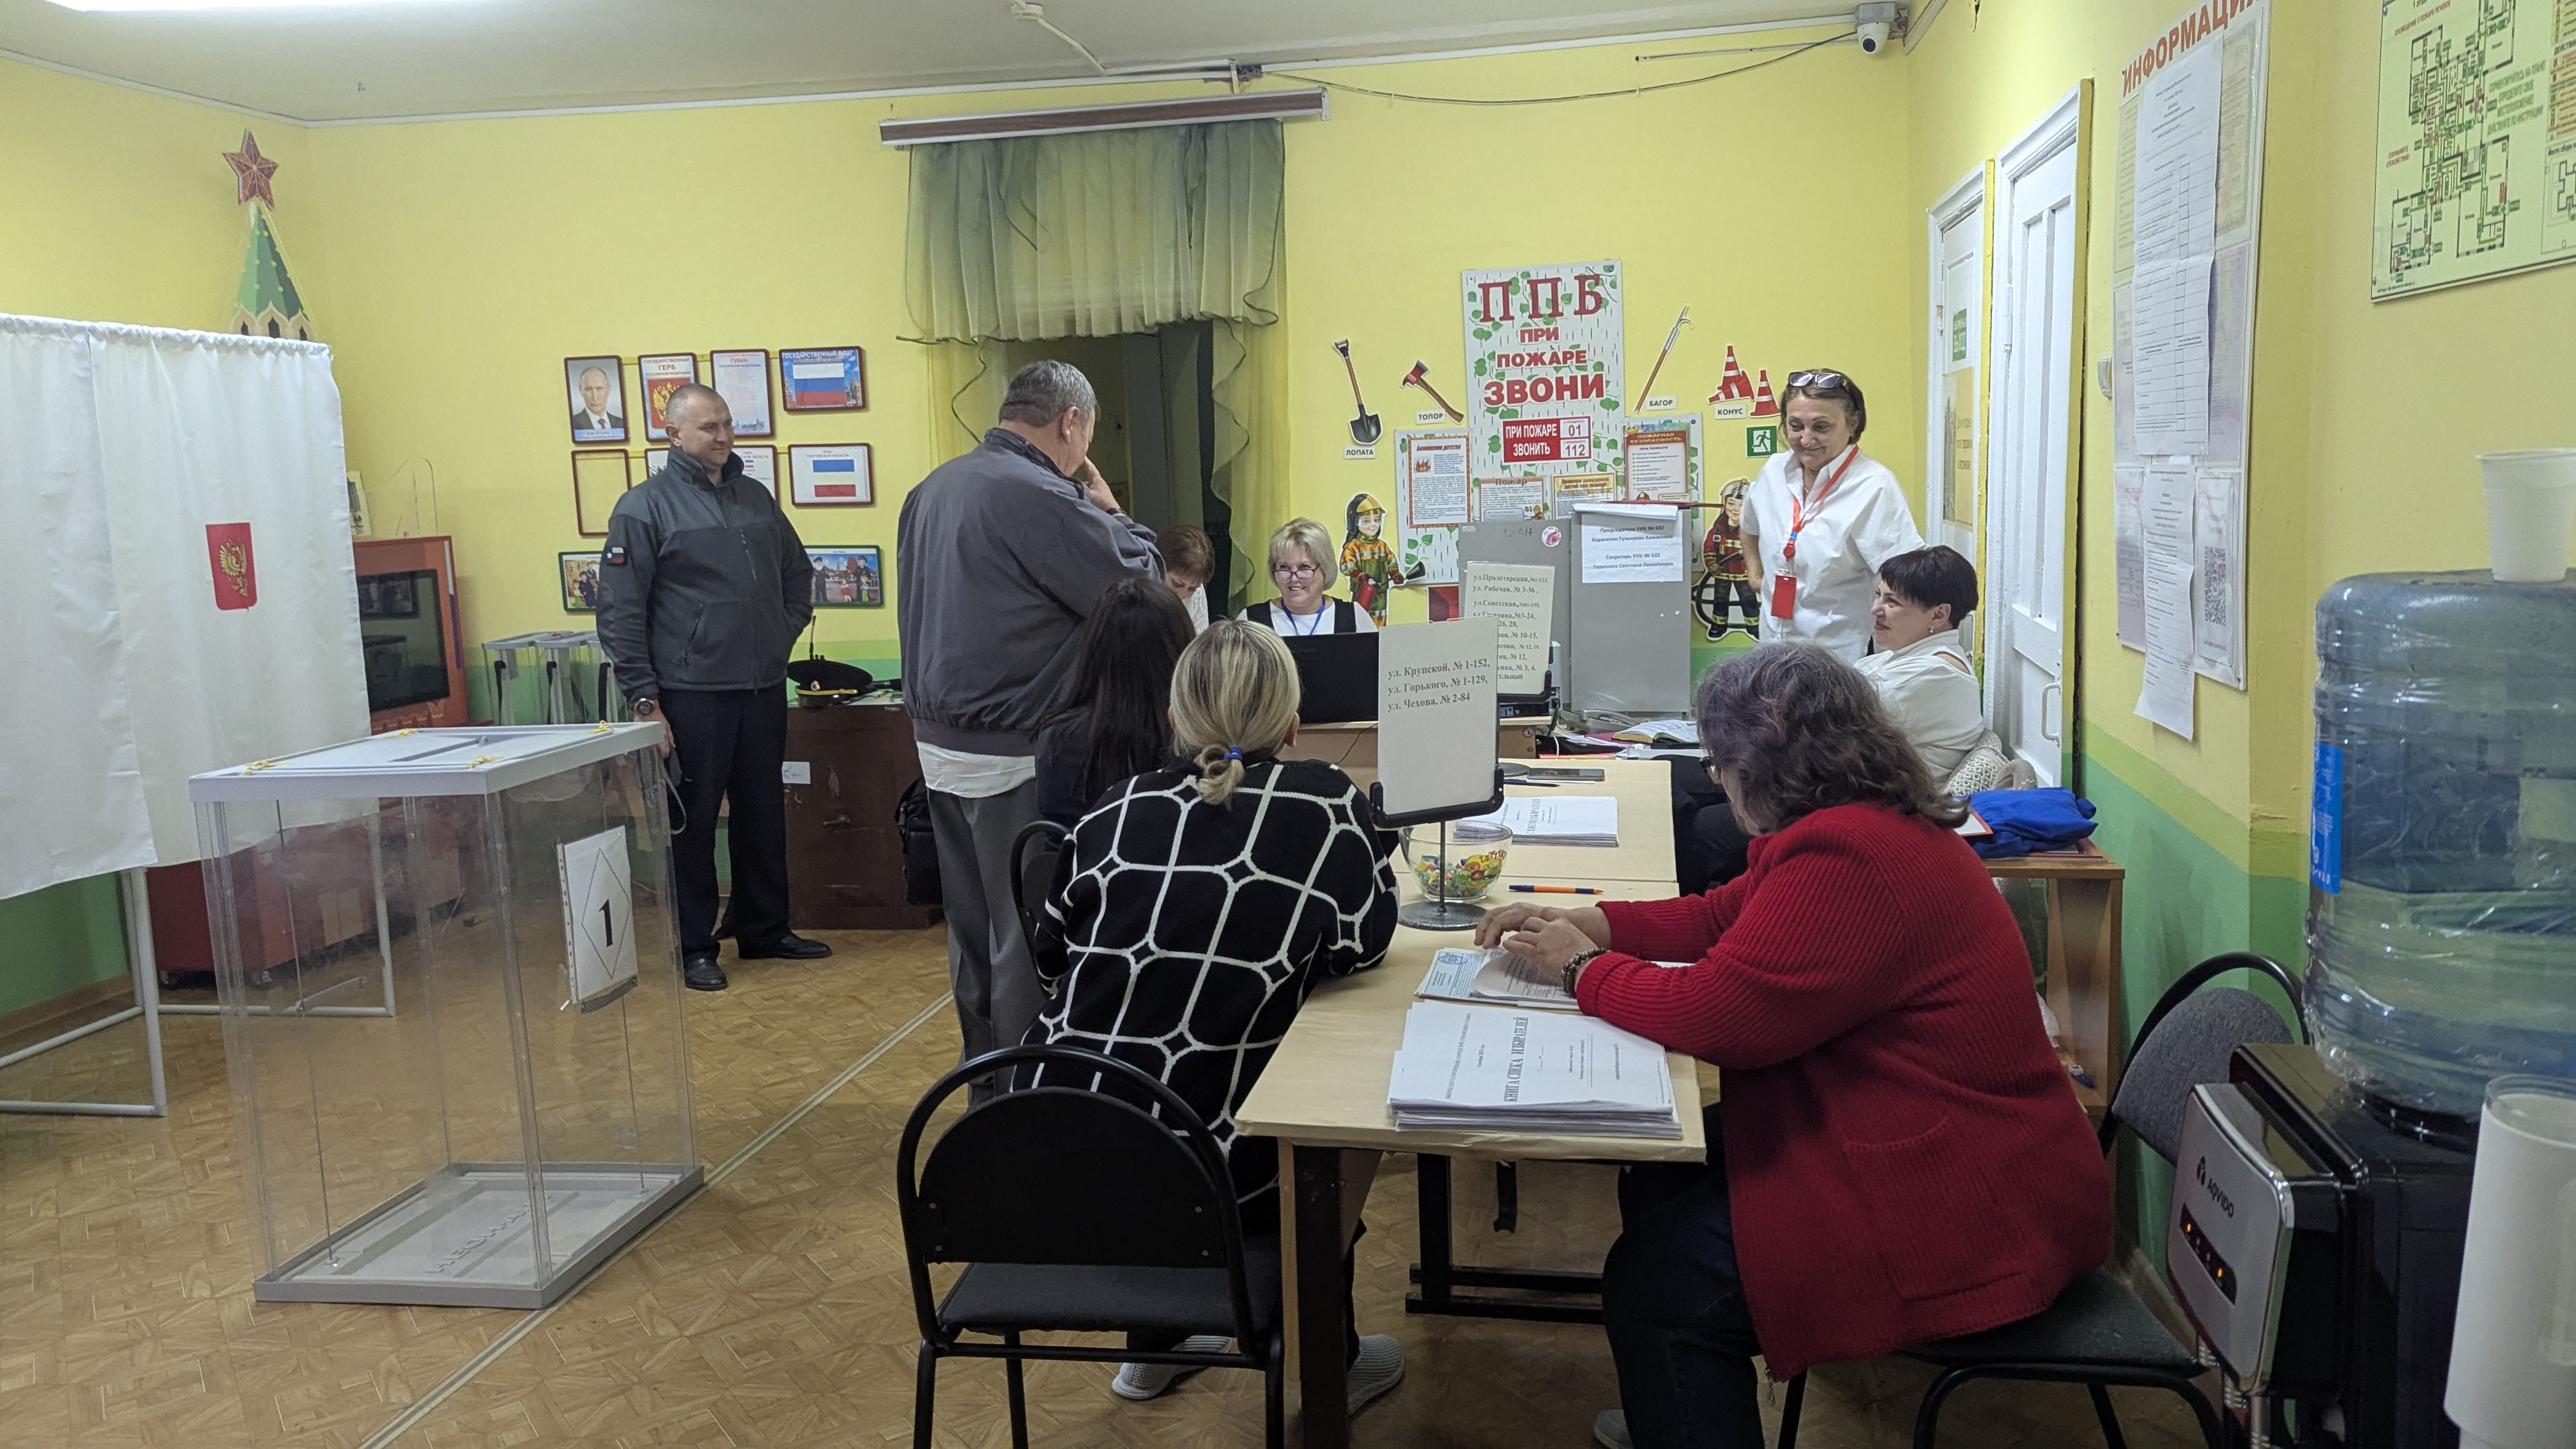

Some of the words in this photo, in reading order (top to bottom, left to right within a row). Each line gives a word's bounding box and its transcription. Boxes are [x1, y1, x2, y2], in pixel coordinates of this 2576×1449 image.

[2122, 0, 2259, 98] ИНФОРМАЦ
[1519, 326, 1560, 343] ПРИ
[782, 350, 837, 359] ГОСУДАРСТВЕННЫЙ
[1497, 349, 1588, 368] ПОЖАРЕ
[1483, 373, 1604, 406] ЗВОНИ
[1505, 425, 1522, 439] ПРИ
[1523, 424, 1558, 438] ПОЖАРЕ
[1568, 424, 1581, 436] 01
[1513, 442, 1551, 456] ЗВОНИТЬ
[1565, 445, 1586, 457] 112
[1495, 478, 1528, 486] Пожар
[1484, 585, 1512, 593] Рабочая,
[1388, 671, 1402, 680] ул.
[1404, 663, 1451, 677] Крупской,
[1452, 661, 1463, 671] №
[1466, 659, 1491, 669] 1-152,
[1388, 687, 1402, 696] ул.
[1404, 681, 1448, 693] Горького,
[1450, 677, 1460, 687] №
[1464, 675, 1488, 685] 1-129,
[1387, 703, 1401, 713] ул.
[1404, 698, 1438, 709] Чехова,
[1439, 694, 1450, 704] №
[1452, 693, 1470, 703] 2-84
[599, 898, 613, 947] 1
[1511, 1016, 1529, 1055] ИЗБИРАТЕЛЕЙ
[1503, 1080, 1520, 1102] КНИГА
